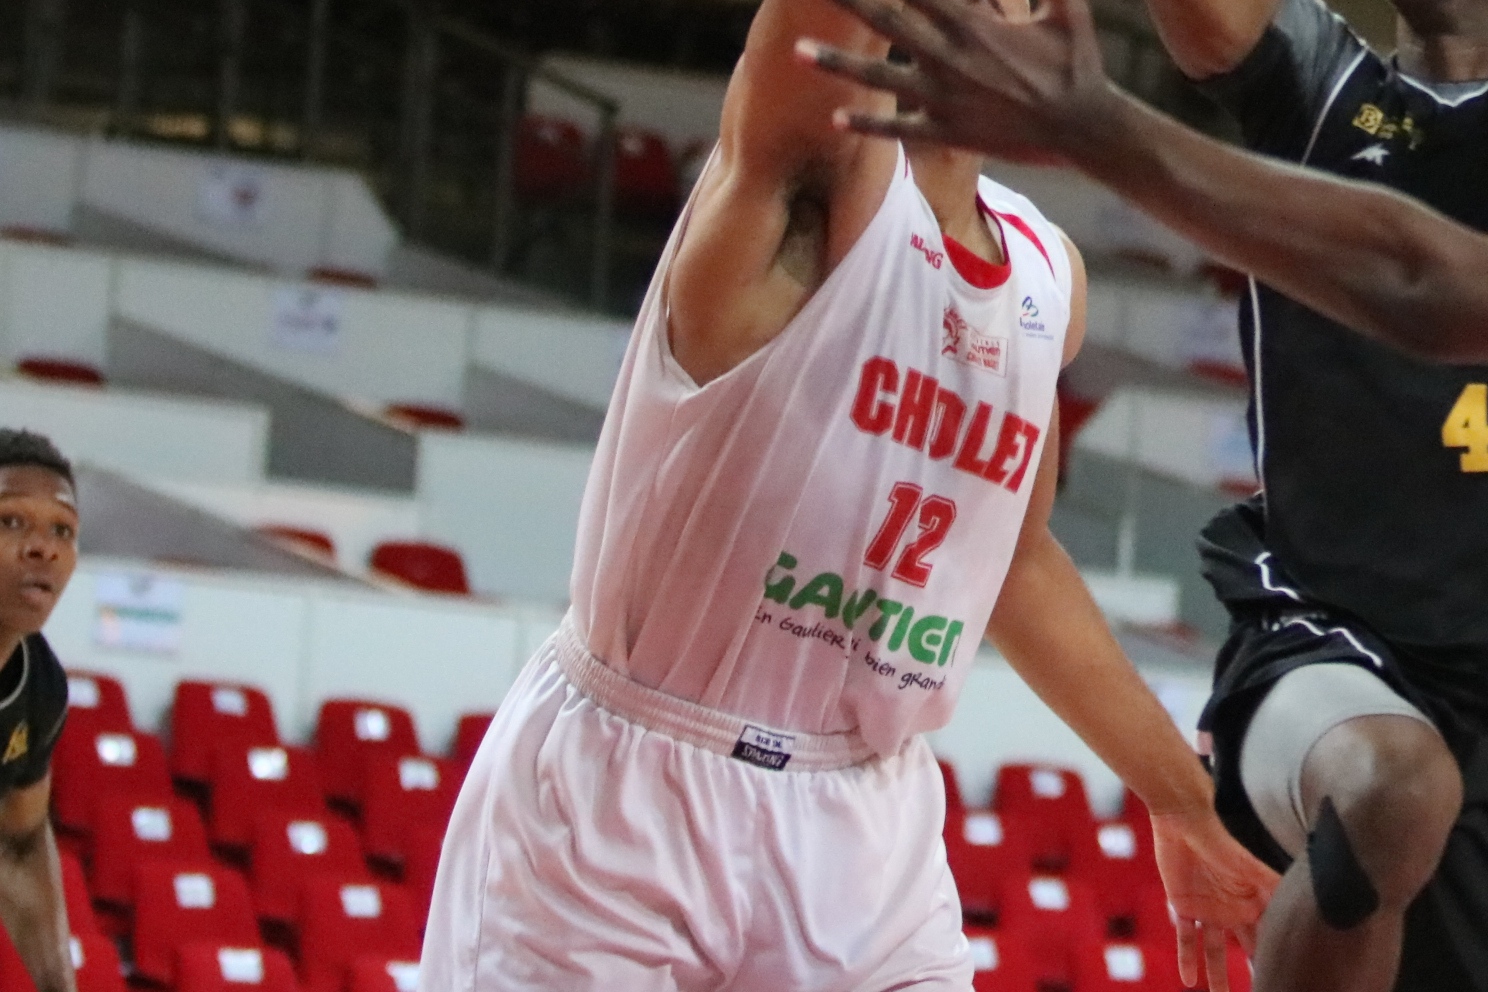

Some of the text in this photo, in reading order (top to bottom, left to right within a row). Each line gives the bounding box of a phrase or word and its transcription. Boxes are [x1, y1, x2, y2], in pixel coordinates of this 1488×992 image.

[850, 355, 1041, 495] CHOLET
[863, 481, 958, 589] 12
[864, 651, 896, 678] bien
